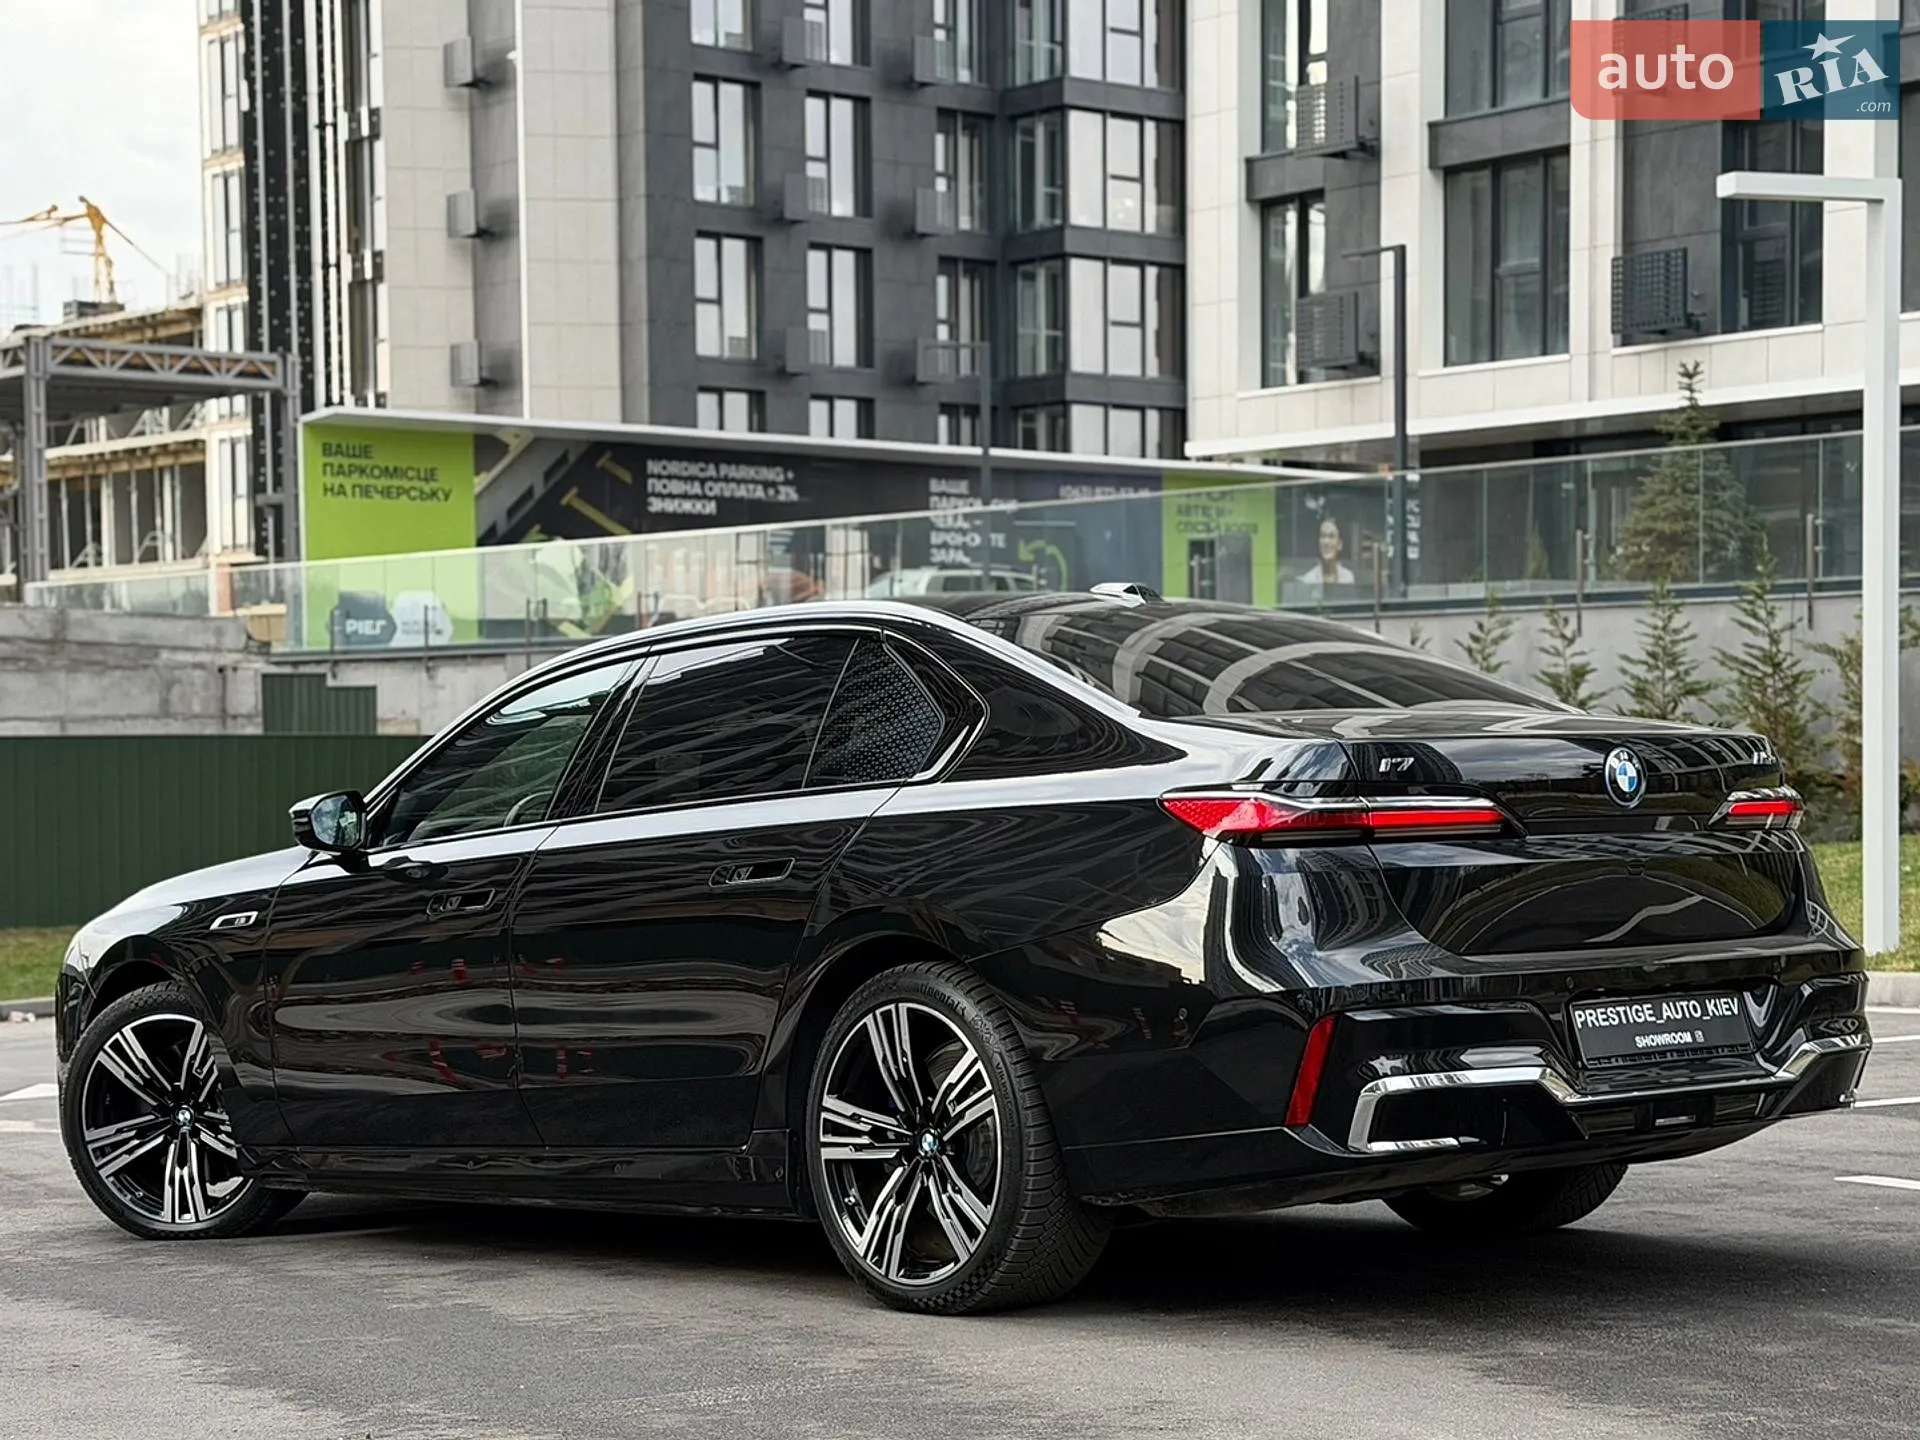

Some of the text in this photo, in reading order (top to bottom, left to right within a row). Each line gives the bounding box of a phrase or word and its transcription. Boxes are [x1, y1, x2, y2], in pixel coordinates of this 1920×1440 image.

[321, 442, 373, 459] ВАШЕ
[322, 462, 439, 484] ПАРКОМІСЦЕ
[647, 459, 717, 478] NORDICA
[719, 463, 785, 482] PARKING
[322, 483, 453, 502] НА ПЕЧЕРСЬКУ
[647, 478, 703, 497] ПОВНА
[704, 480, 766, 499] ОПЛАТА
[647, 497, 717, 515] ЗНИЖКИ
[1574, 998, 1739, 1029] PRESTIGE_AUTO_KIEV
[1635, 1031, 1692, 1048] SHOWROOM
